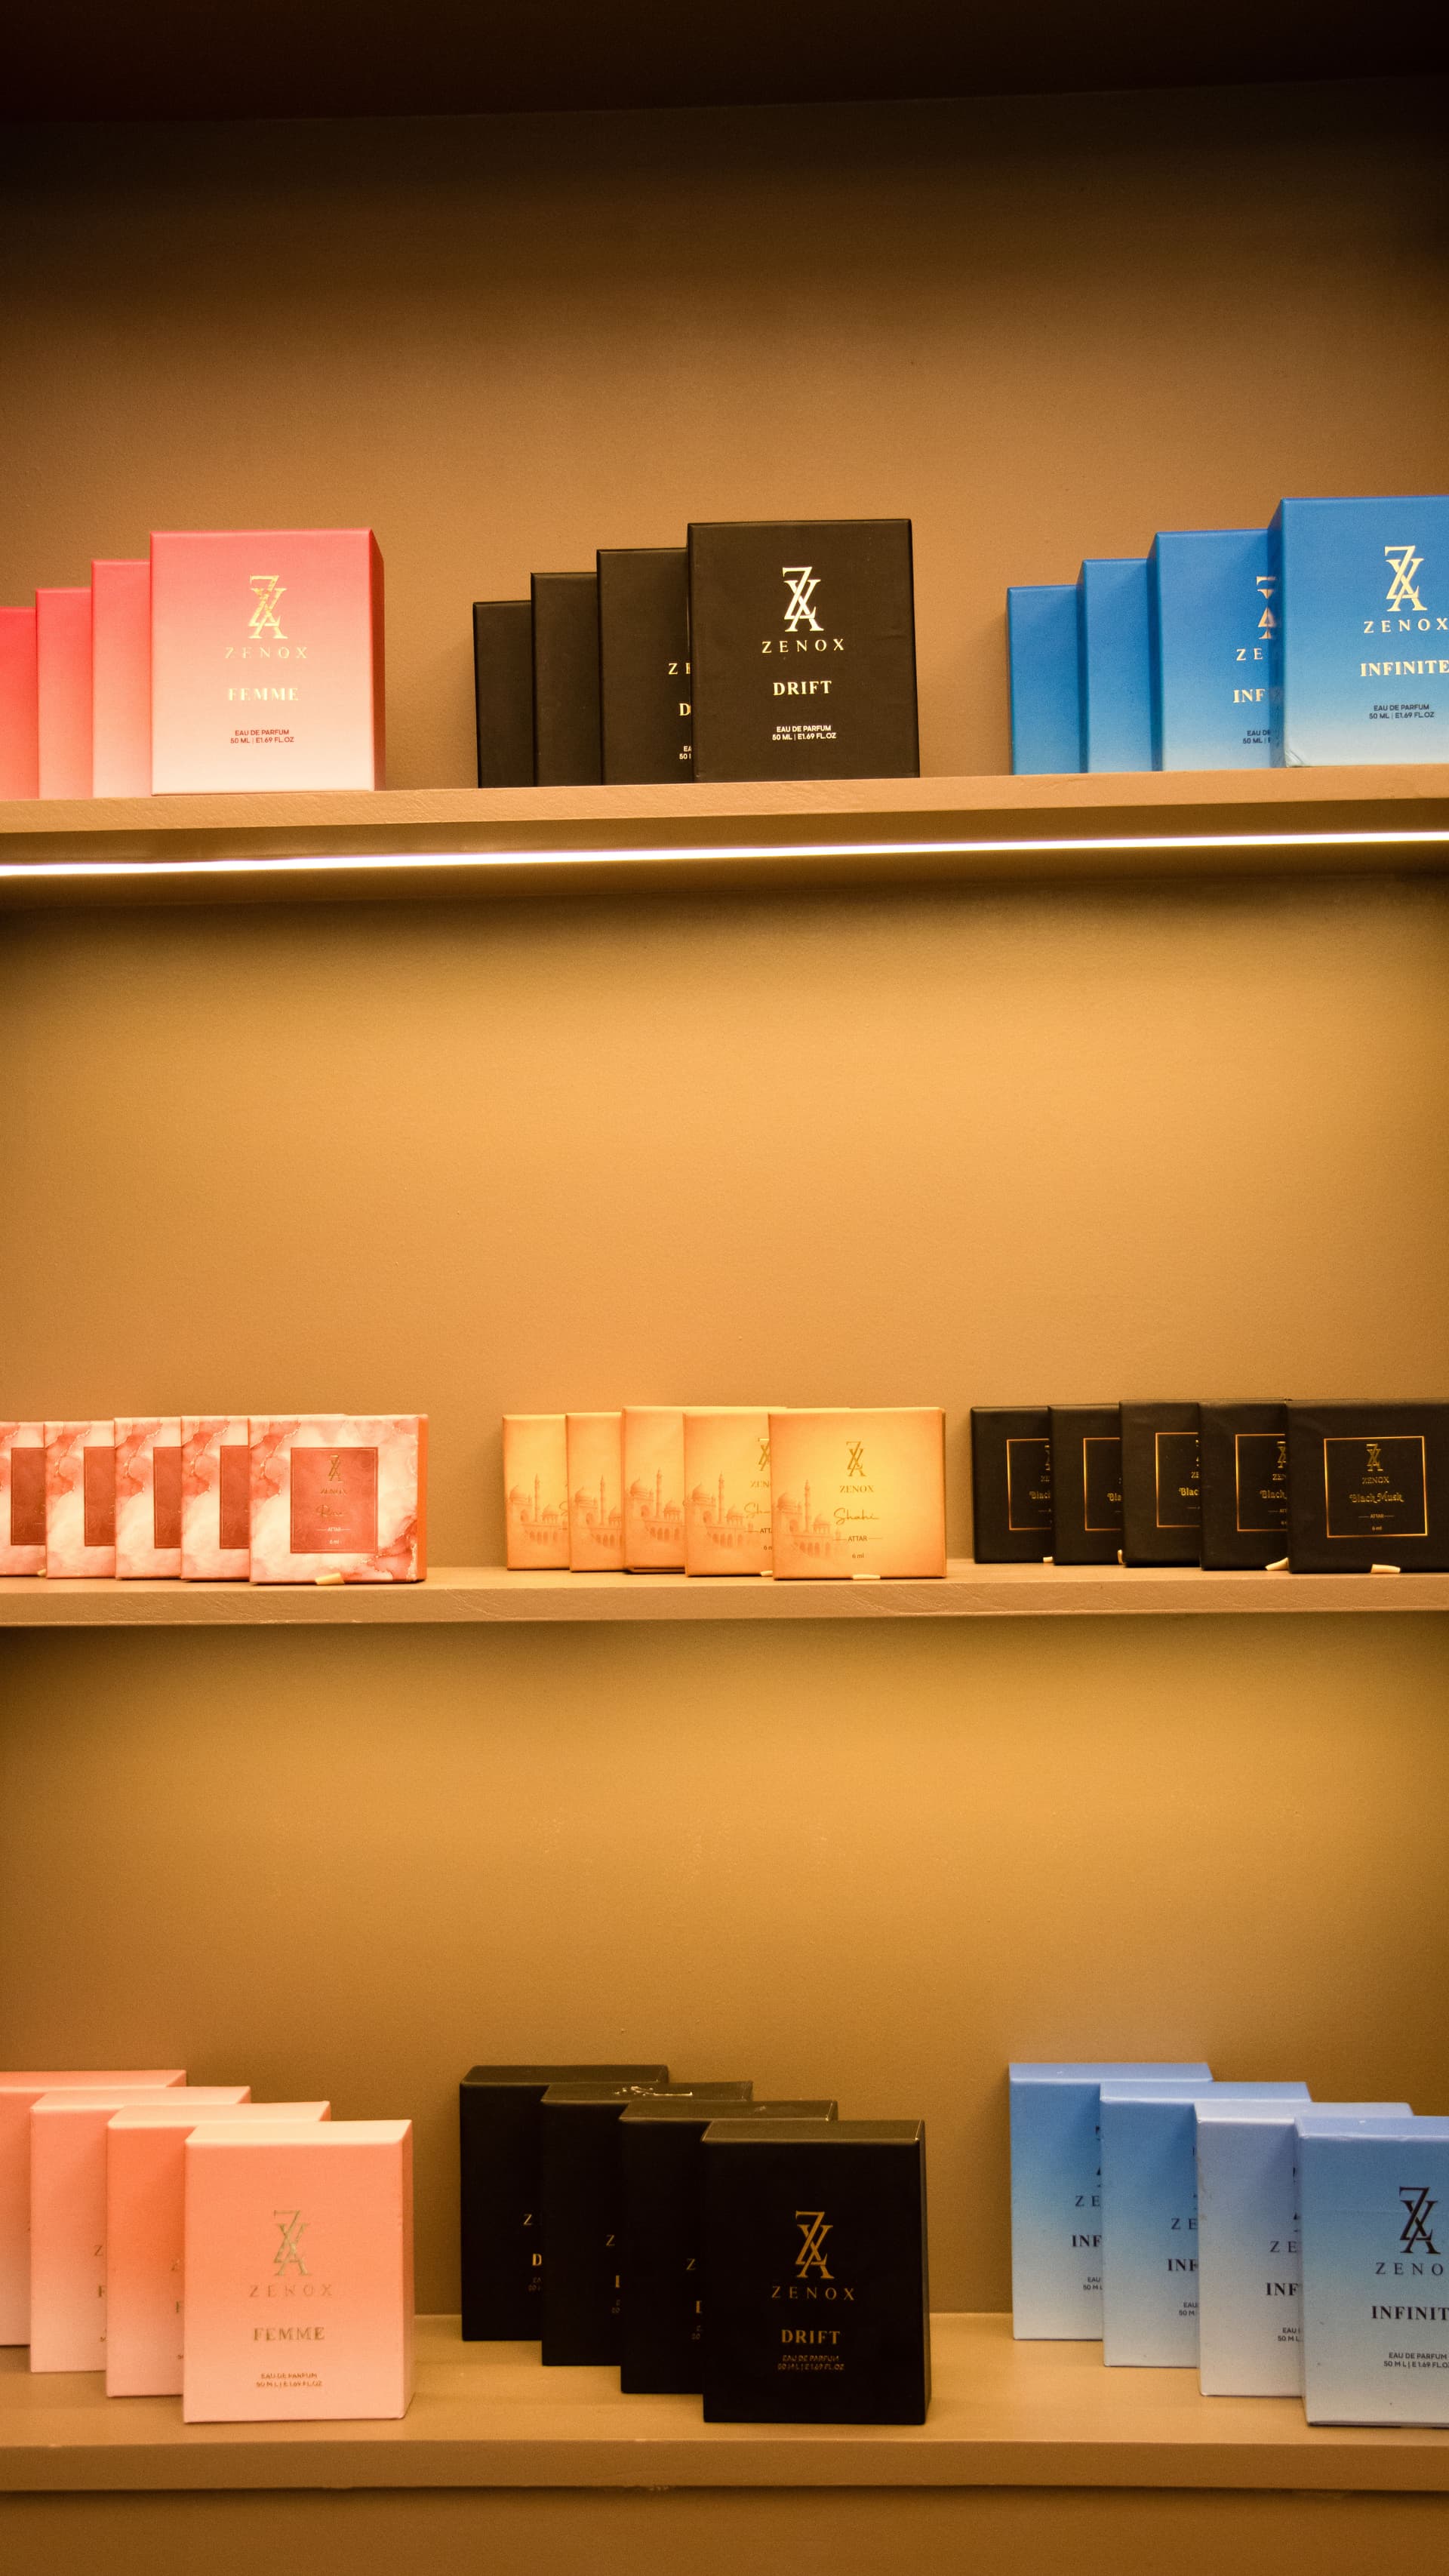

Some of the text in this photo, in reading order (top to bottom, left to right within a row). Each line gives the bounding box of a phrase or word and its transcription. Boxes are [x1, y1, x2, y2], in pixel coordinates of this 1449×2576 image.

[1364, 617, 1449, 634] ZENOX
[225, 646, 307, 659] ZENOX
[761, 639, 844, 654] ZENOX
[1360, 659, 1449, 677] INFINITE
[228, 688, 299, 701] FEMME
[773, 680, 832, 696] DRIFT
[839, 1485, 875, 1493] ZENOX
[1179, 1487, 1199, 1497] Blac
[1375, 2262, 1444, 2276] ZENO
[249, 2284, 332, 2298] ZENOX
[771, 2285, 855, 2301] ZENOX
[1371, 2305, 1449, 2321] INFINIT
[253, 2327, 325, 2341] FEMME
[781, 2328, 841, 2344] DRIFT
